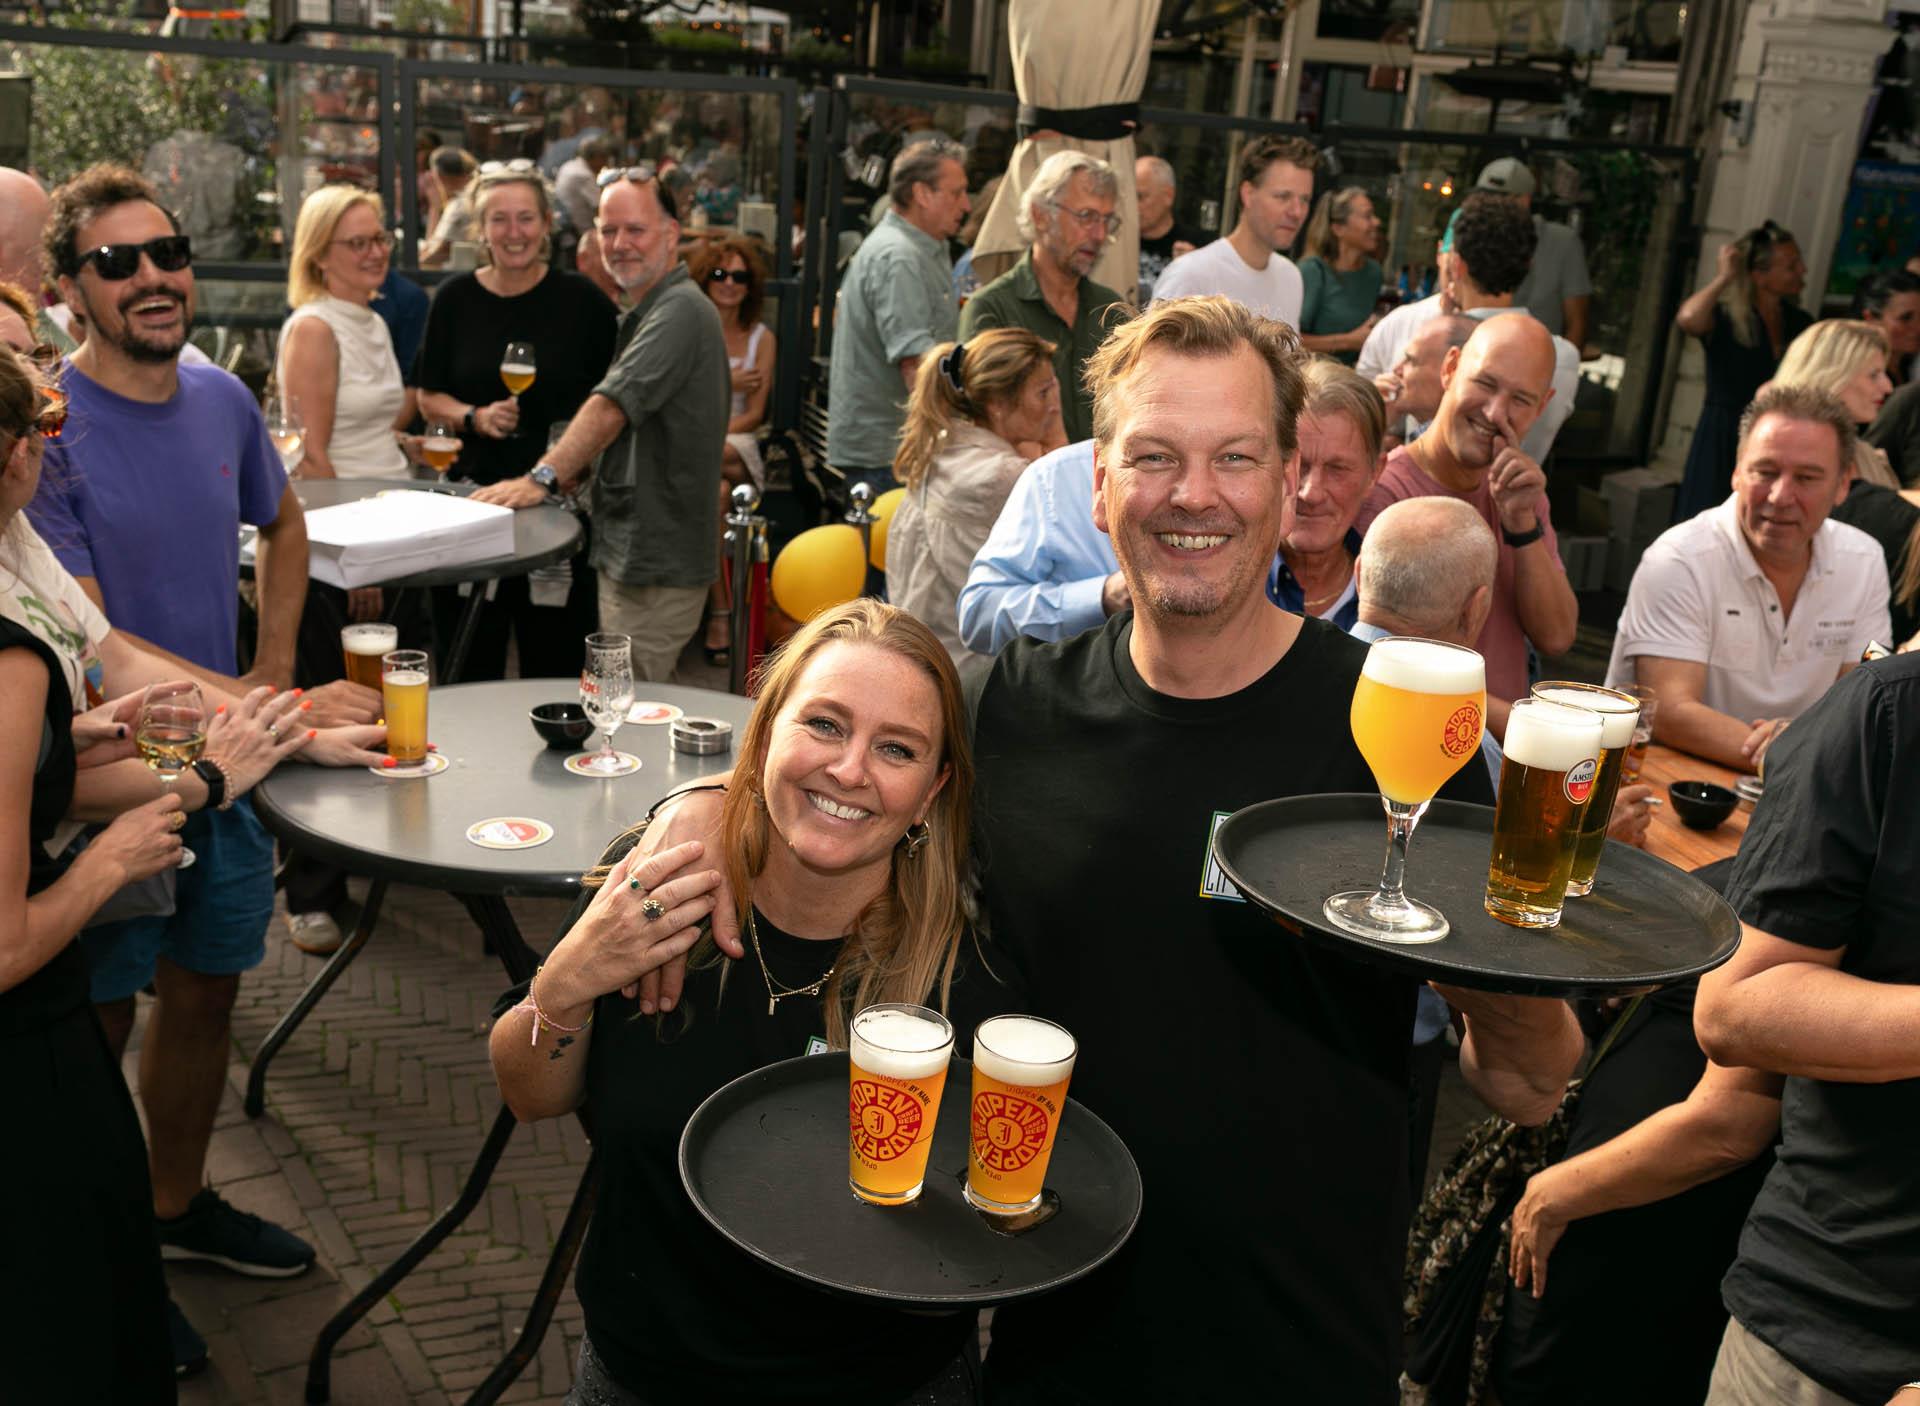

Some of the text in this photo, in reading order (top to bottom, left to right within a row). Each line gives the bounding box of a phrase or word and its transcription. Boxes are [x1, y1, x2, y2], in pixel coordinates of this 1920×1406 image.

[1446, 708, 1479, 734] JOPEN
[1572, 772, 1593, 781] AMSTE
[851, 1082, 916, 1114] JOPEN
[908, 1084, 919, 1093] BY
[917, 1089, 931, 1107] NAME
[898, 1114, 920, 1125] BEER
[974, 1094, 1042, 1124] JOPEN
[851, 1124, 919, 1160] JOPEN
[975, 1136, 1043, 1169] JOPEN
[862, 1158, 878, 1170] OPEN
[986, 1169, 1002, 1181] OPEN
